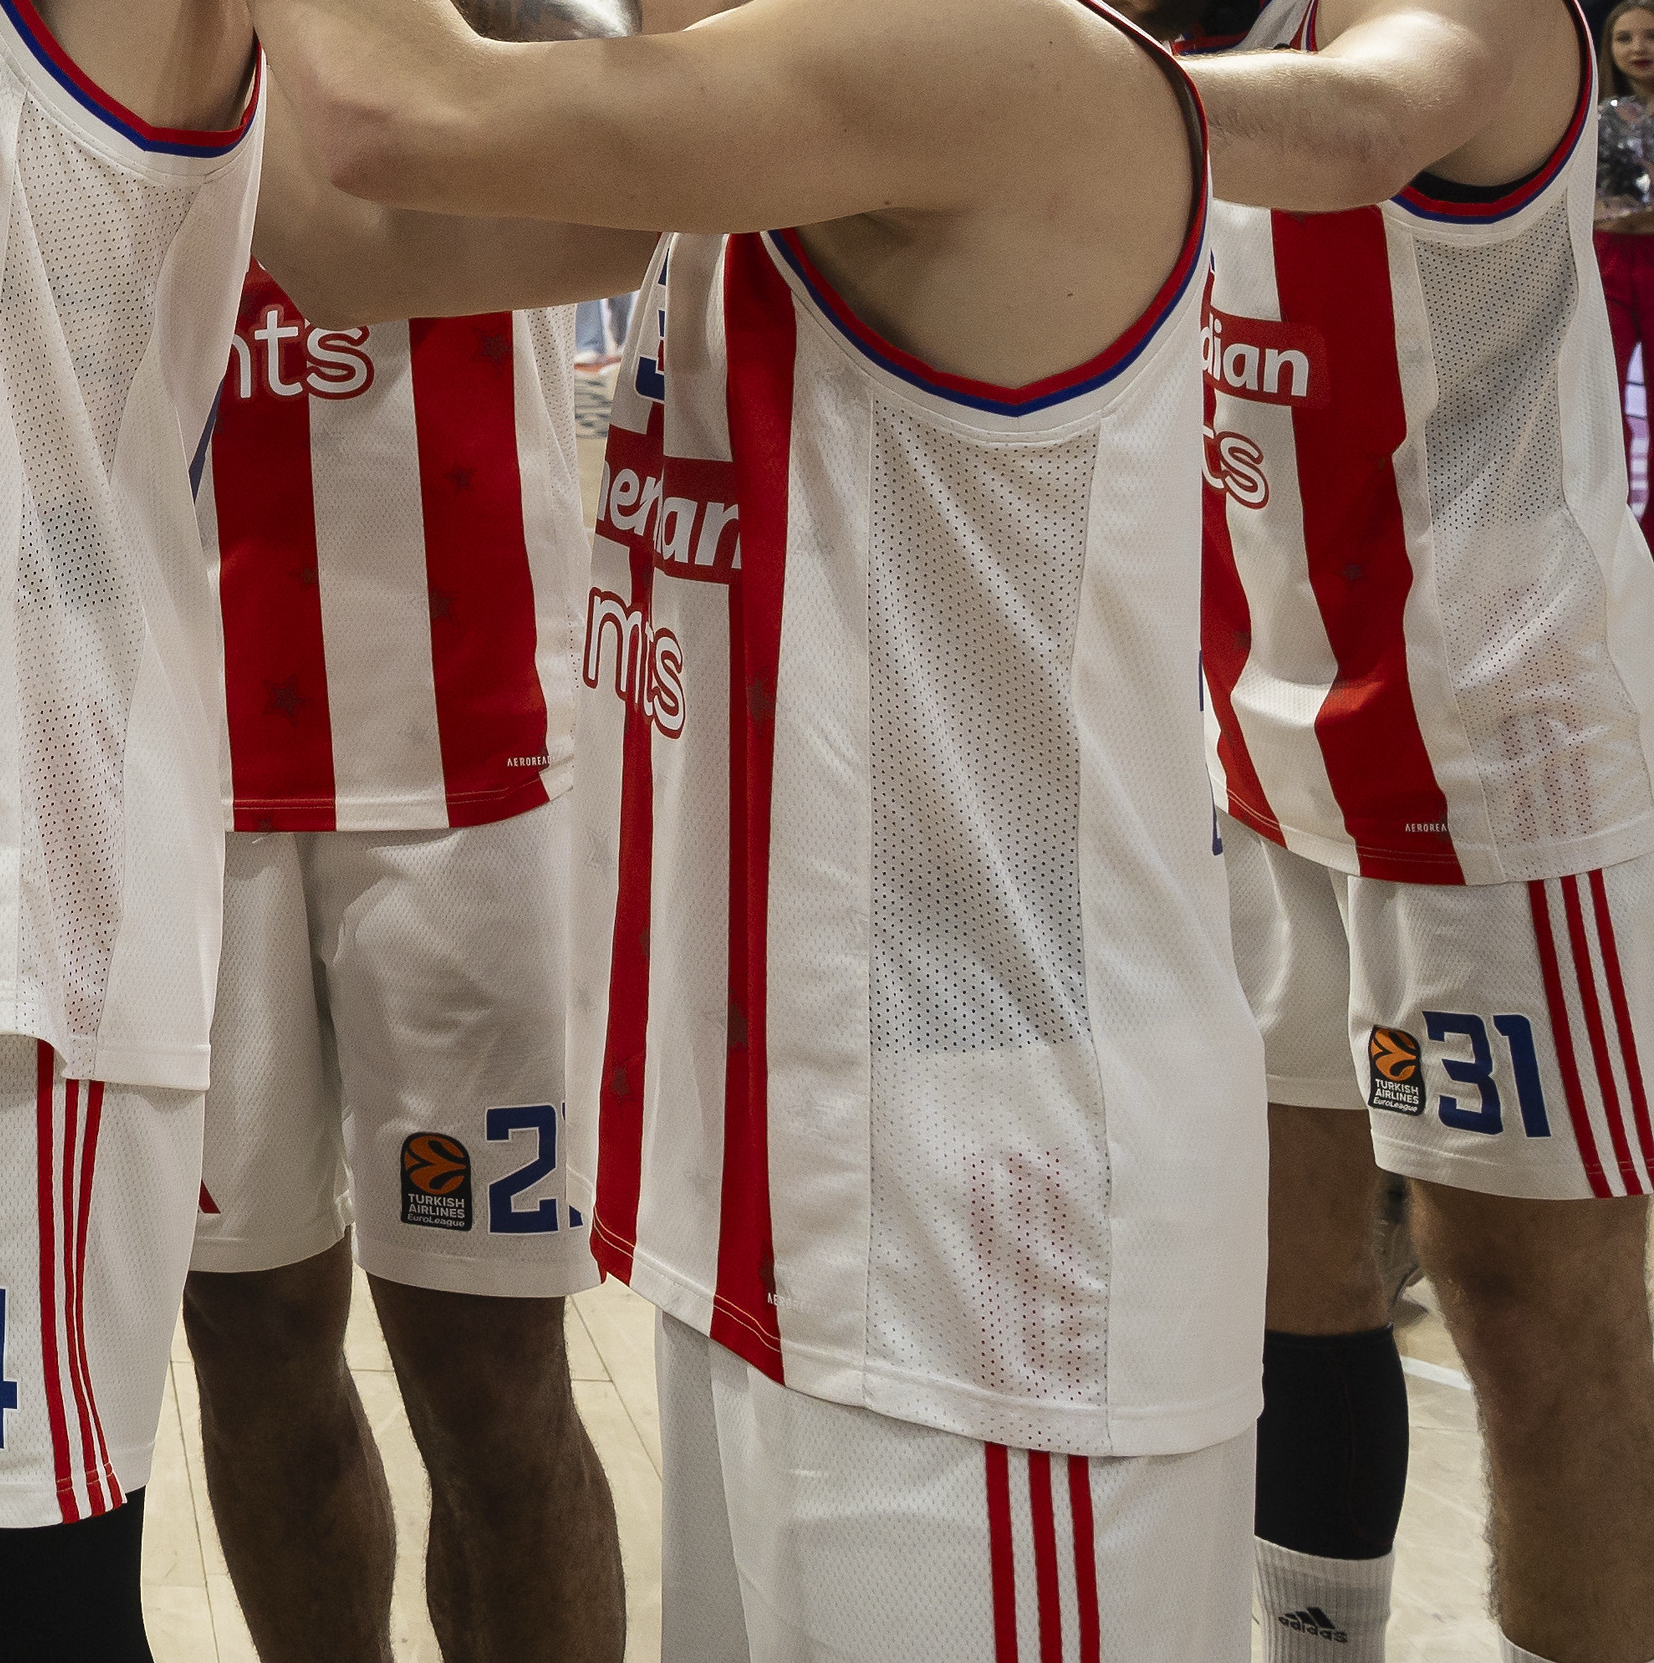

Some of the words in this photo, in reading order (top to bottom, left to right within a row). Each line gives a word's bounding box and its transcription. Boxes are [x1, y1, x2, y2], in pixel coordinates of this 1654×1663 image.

[1422, 1010, 1552, 1139] 31
[1374, 1078, 1419, 1096] TURKISH
[1374, 1087, 1420, 1105] AIRLINES
[407, 1193, 465, 1208] TURKISH
[407, 1213, 465, 1228] EuroLeague
[408, 1204, 466, 1219] AIRLINES
[1278, 1616, 1349, 1644] adidas
